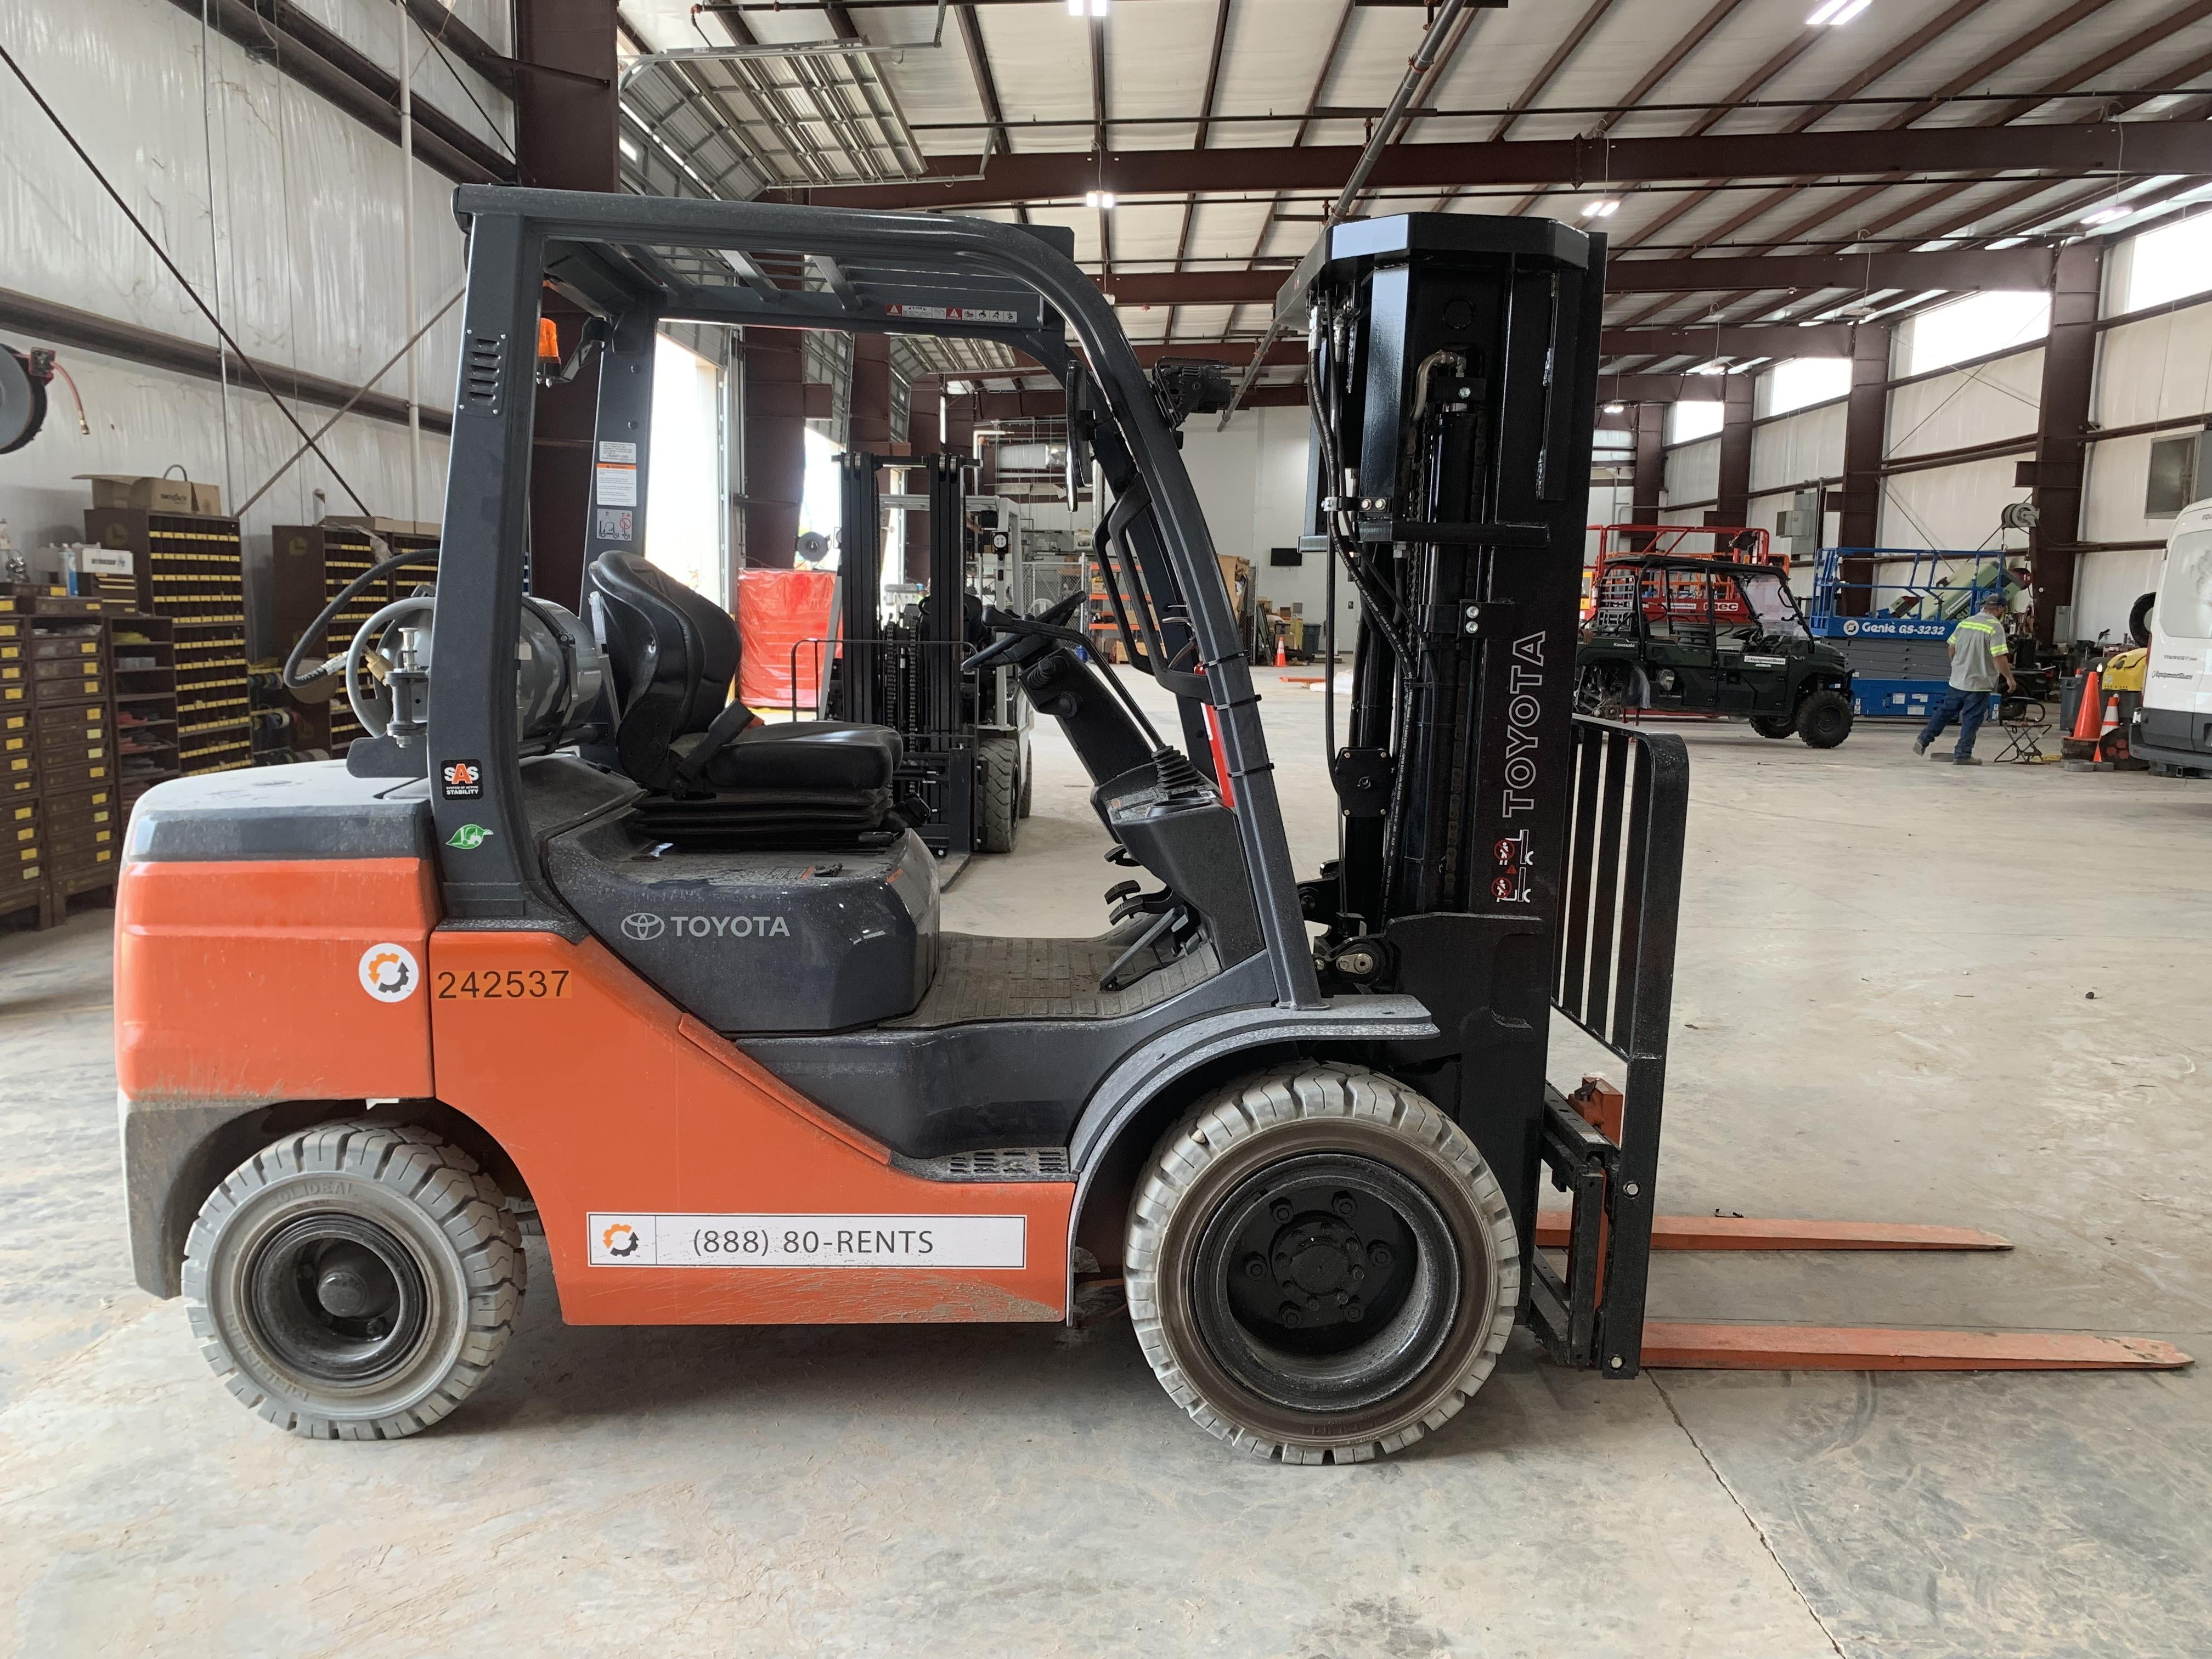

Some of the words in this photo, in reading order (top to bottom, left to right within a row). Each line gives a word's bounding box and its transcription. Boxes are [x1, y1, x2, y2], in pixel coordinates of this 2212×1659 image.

[1898, 625, 1945, 635] GS-3232
[1502, 630, 1546, 818] TOYOTA
[444, 763, 479, 785] SAS
[670, 916, 791, 937] TOYOTA
[437, 970, 569, 998] 242537
[693, 1228, 770, 1257] (888)
[783, 1229, 934, 1254] 80-RENTS
